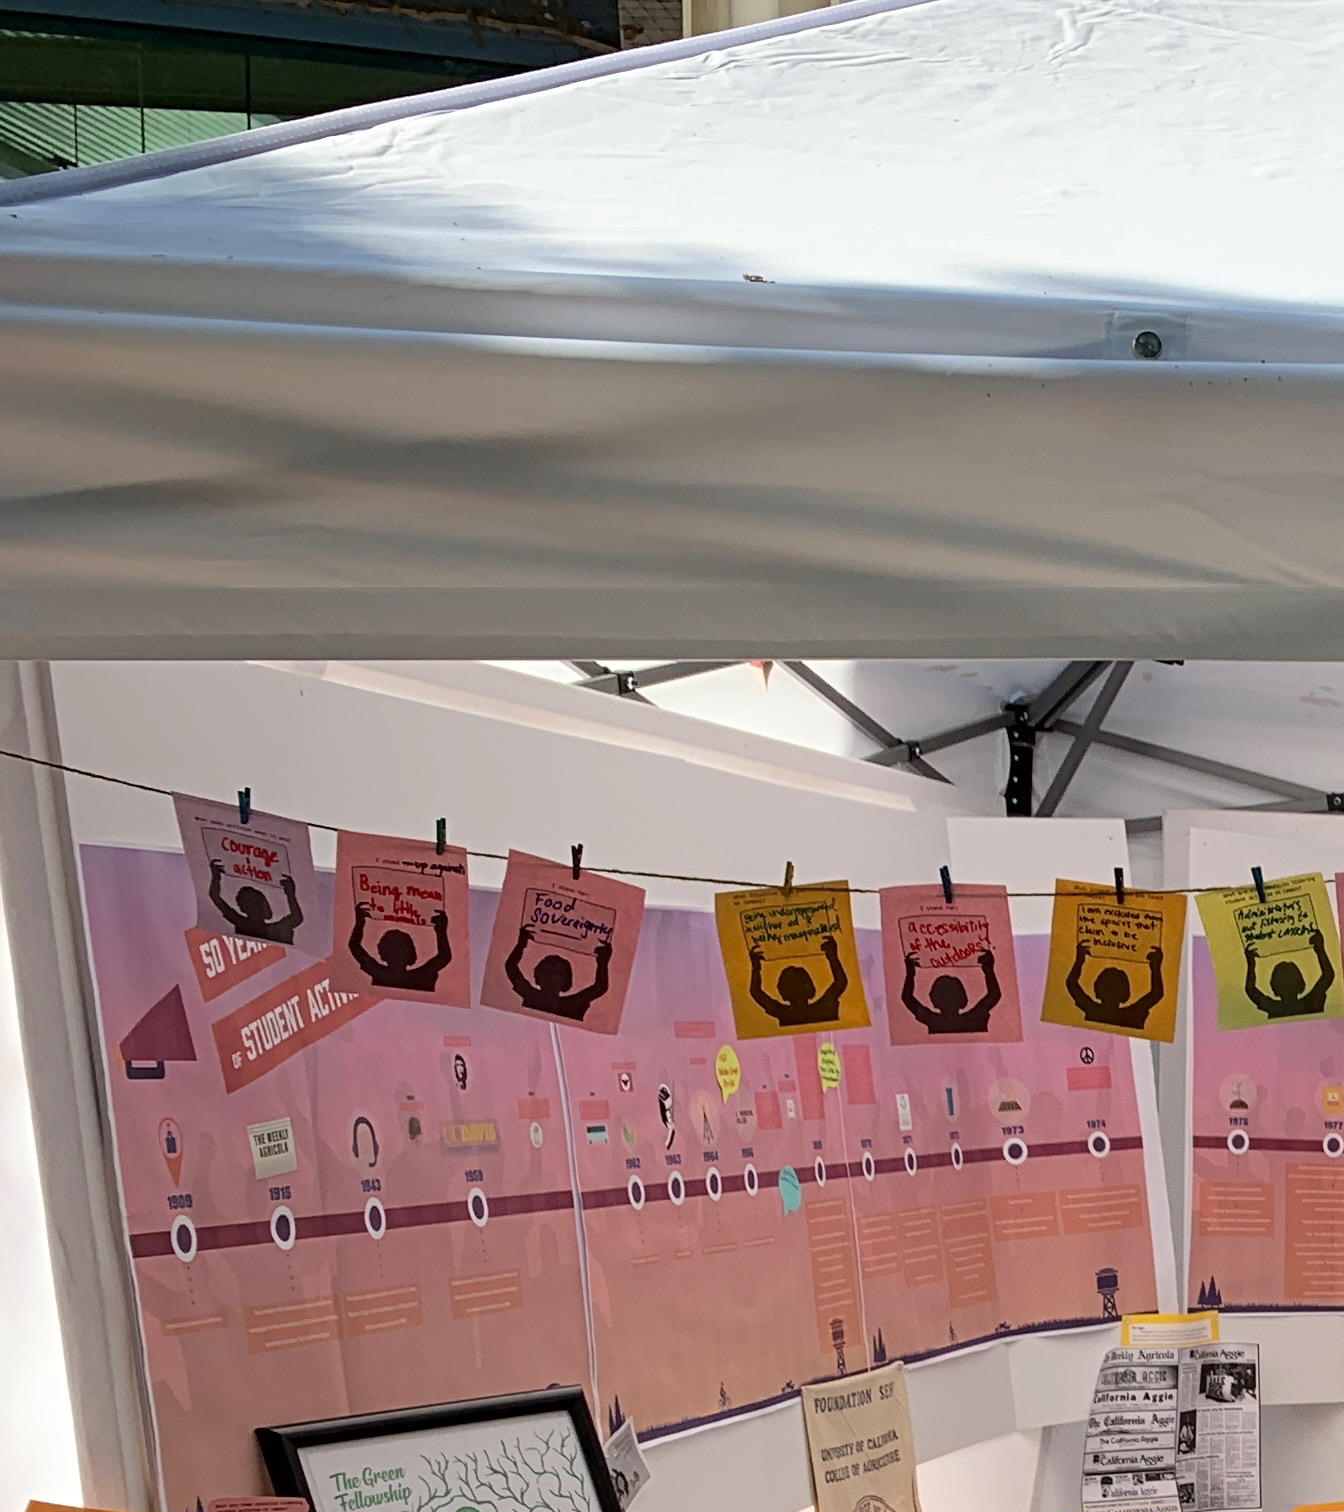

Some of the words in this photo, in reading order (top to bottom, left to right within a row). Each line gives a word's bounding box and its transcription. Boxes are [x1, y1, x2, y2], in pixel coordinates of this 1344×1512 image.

[359, 873, 402, 901] Being
[406, 885, 442, 901] mean
[534, 891, 577, 912] Food
[908, 920, 991, 944] accessibility
[910, 937, 921, 951] of
[924, 937, 951, 952] the
[240, 995, 306, 1062] STUDENT
[253, 1132, 266, 1146] THE
[267, 1128, 289, 1145] WEEKLY
[259, 1142, 290, 1158] AGRICOLA
[814, 1388, 873, 1413] FOUNDATION
[1143, 1391, 1174, 1403] Aggie
[330, 1472, 362, 1492] The
[362, 1465, 407, 1486] Green
[334, 1483, 412, 1512] Fellowship
